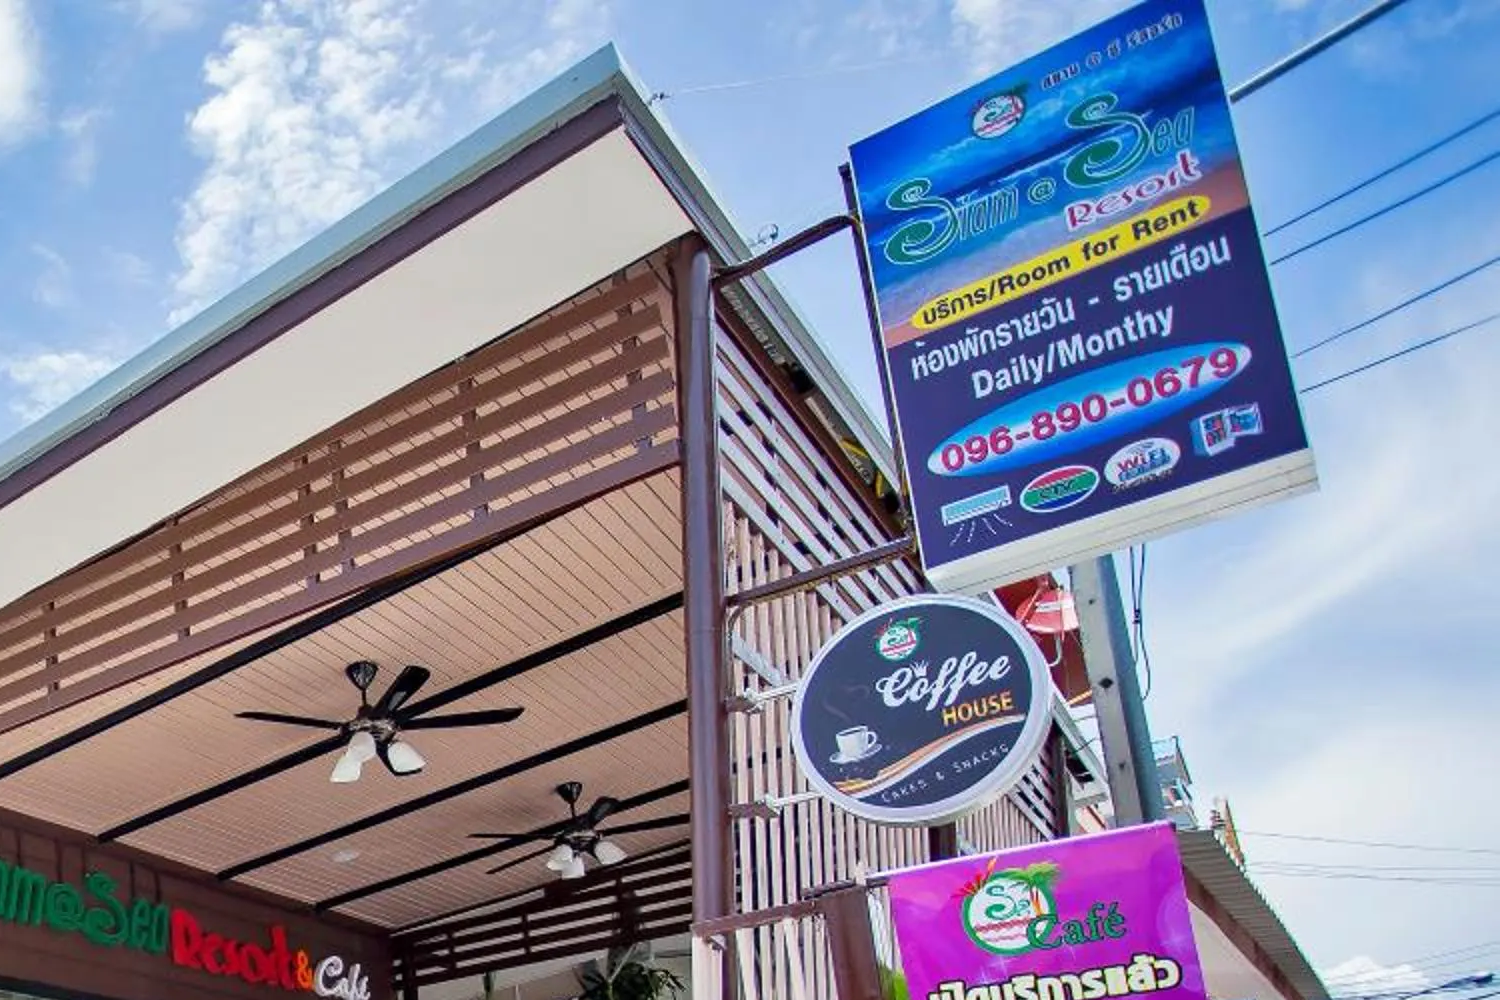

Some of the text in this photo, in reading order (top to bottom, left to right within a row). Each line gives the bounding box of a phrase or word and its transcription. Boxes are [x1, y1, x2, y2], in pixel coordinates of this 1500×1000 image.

[1063, 92, 1195, 186] Sea
[1065, 149, 1203, 233] Resort
[1082, 233, 1119, 262] for
[1133, 200, 1200, 243] Rent
[911, 294, 1076, 381] ห้องพักรายวัน
[1114, 235, 1232, 302] รายเดือน
[971, 304, 1174, 400] Daily/Monthy
[940, 347, 1238, 474] 096-890-0679
[876, 650, 1011, 712] Coffee
[943, 691, 1015, 727] HOUSE
[1026, 901, 1128, 950] Café
